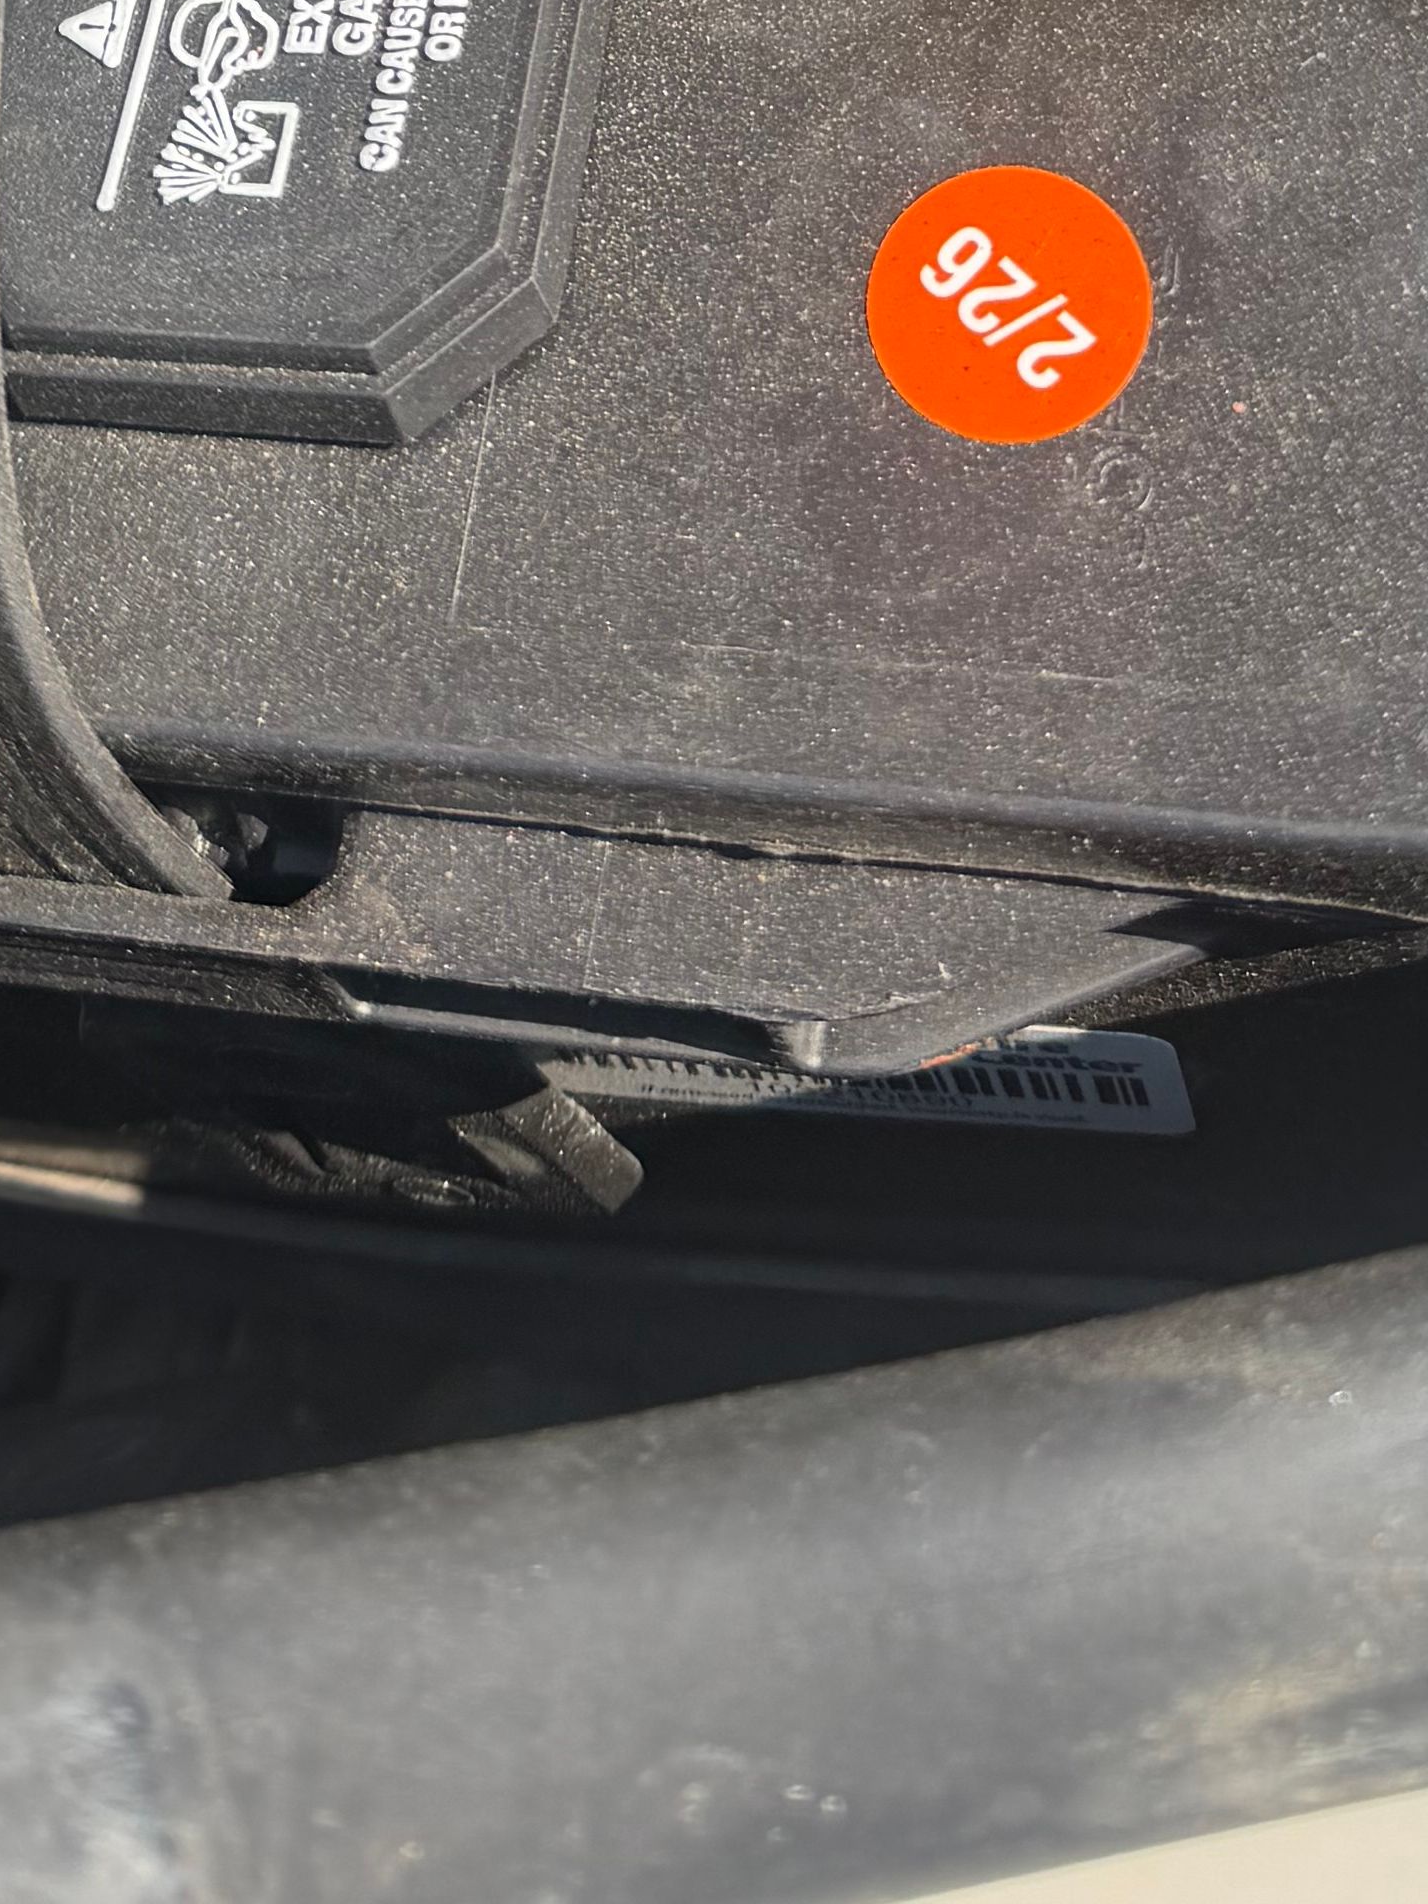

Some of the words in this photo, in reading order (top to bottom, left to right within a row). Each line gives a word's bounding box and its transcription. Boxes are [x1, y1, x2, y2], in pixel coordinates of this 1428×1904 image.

[424, 12, 470, 61] OR
[359, 98, 409, 171] CAN
[918, 225, 1098, 391] 2/26
